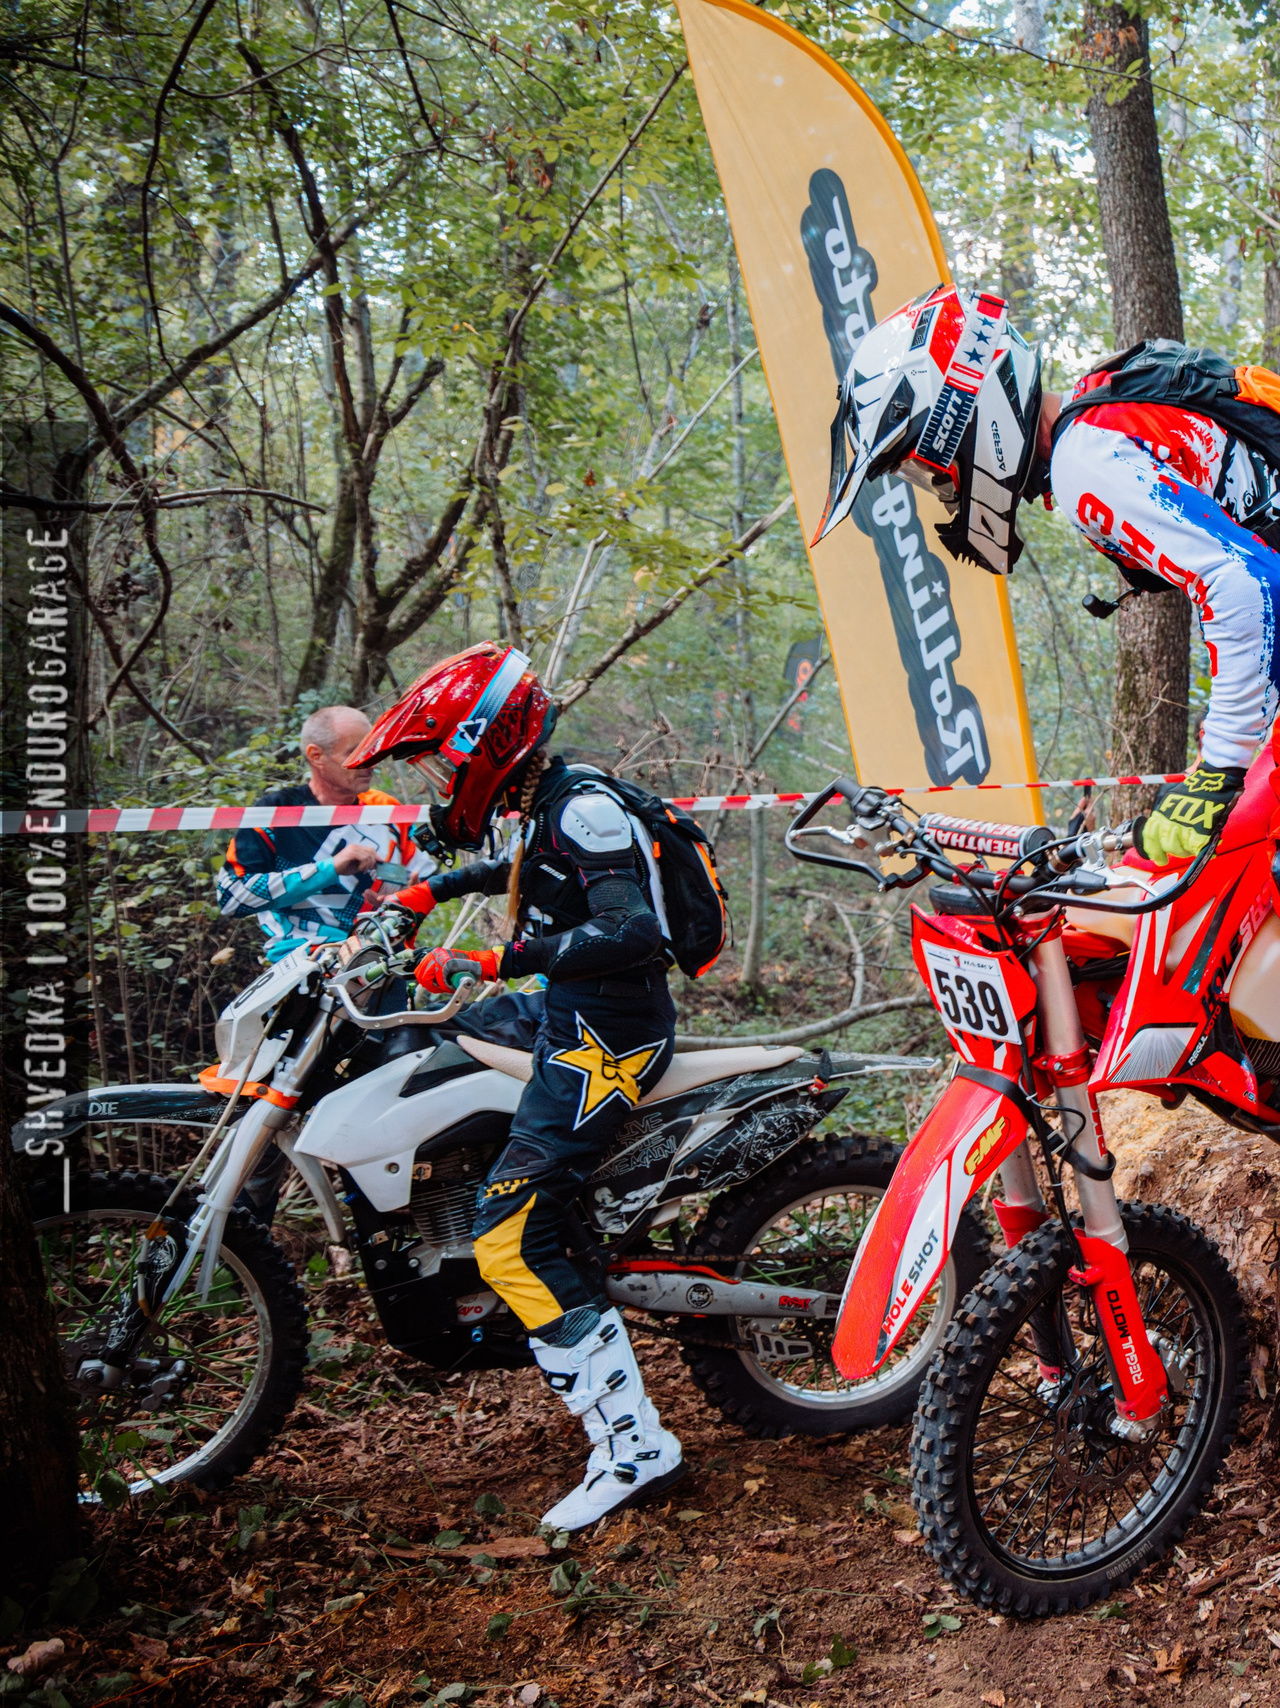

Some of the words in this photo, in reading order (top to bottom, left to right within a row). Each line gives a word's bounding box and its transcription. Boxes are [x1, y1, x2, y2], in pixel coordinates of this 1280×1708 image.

[931, 390, 964, 454] SCOTT
[1160, 794, 1225, 829] FOX
[934, 968, 1009, 1037] 539
[1187, 1004, 1222, 1067] REGULMOTO
[88, 1102, 119, 1117] DIE
[964, 1115, 1007, 1177] FMF
[881, 1227, 940, 1336] HOLESHOT
[1106, 1289, 1145, 1387] REGULMOTO
